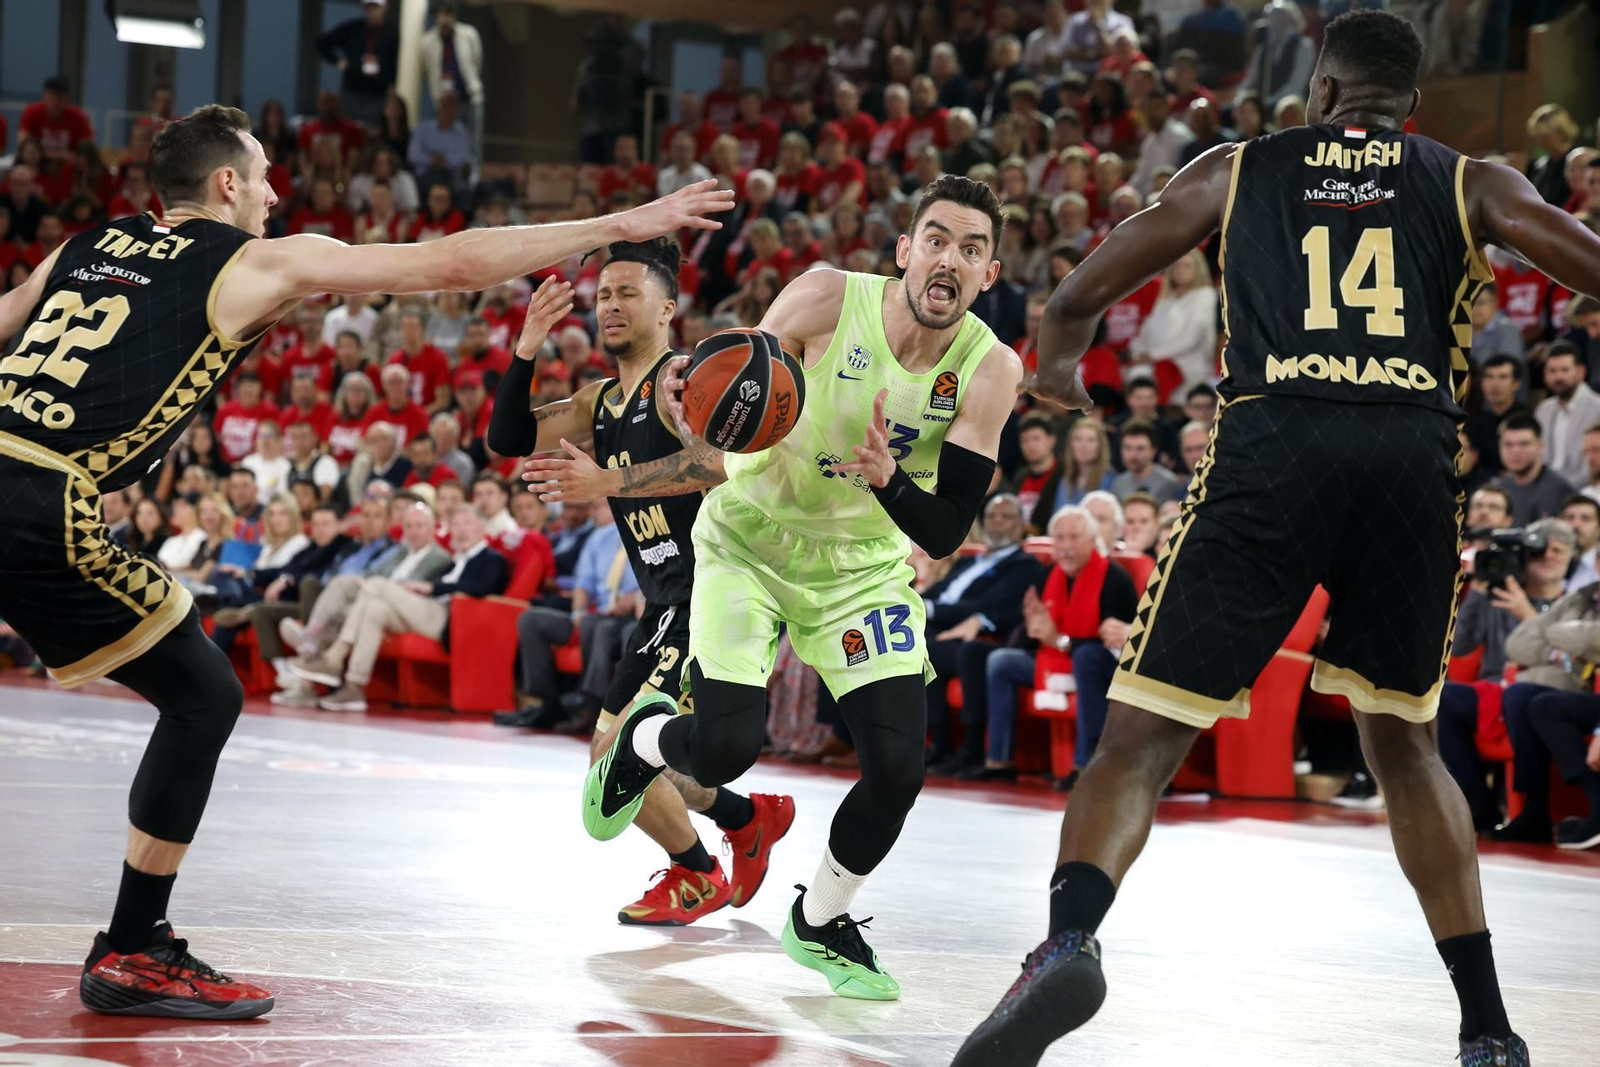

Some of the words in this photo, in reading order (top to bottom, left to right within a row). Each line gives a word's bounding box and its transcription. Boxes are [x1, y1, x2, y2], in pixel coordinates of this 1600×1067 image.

[1304, 140, 1402, 173] JAITEH
[1303, 189, 1352, 204] MICHE
[1301, 225, 1405, 337] 14
[0, 290, 131, 388] 22
[1266, 353, 1438, 390] MONACO
[885, 418, 920, 461] 3
[863, 604, 915, 655] 13
